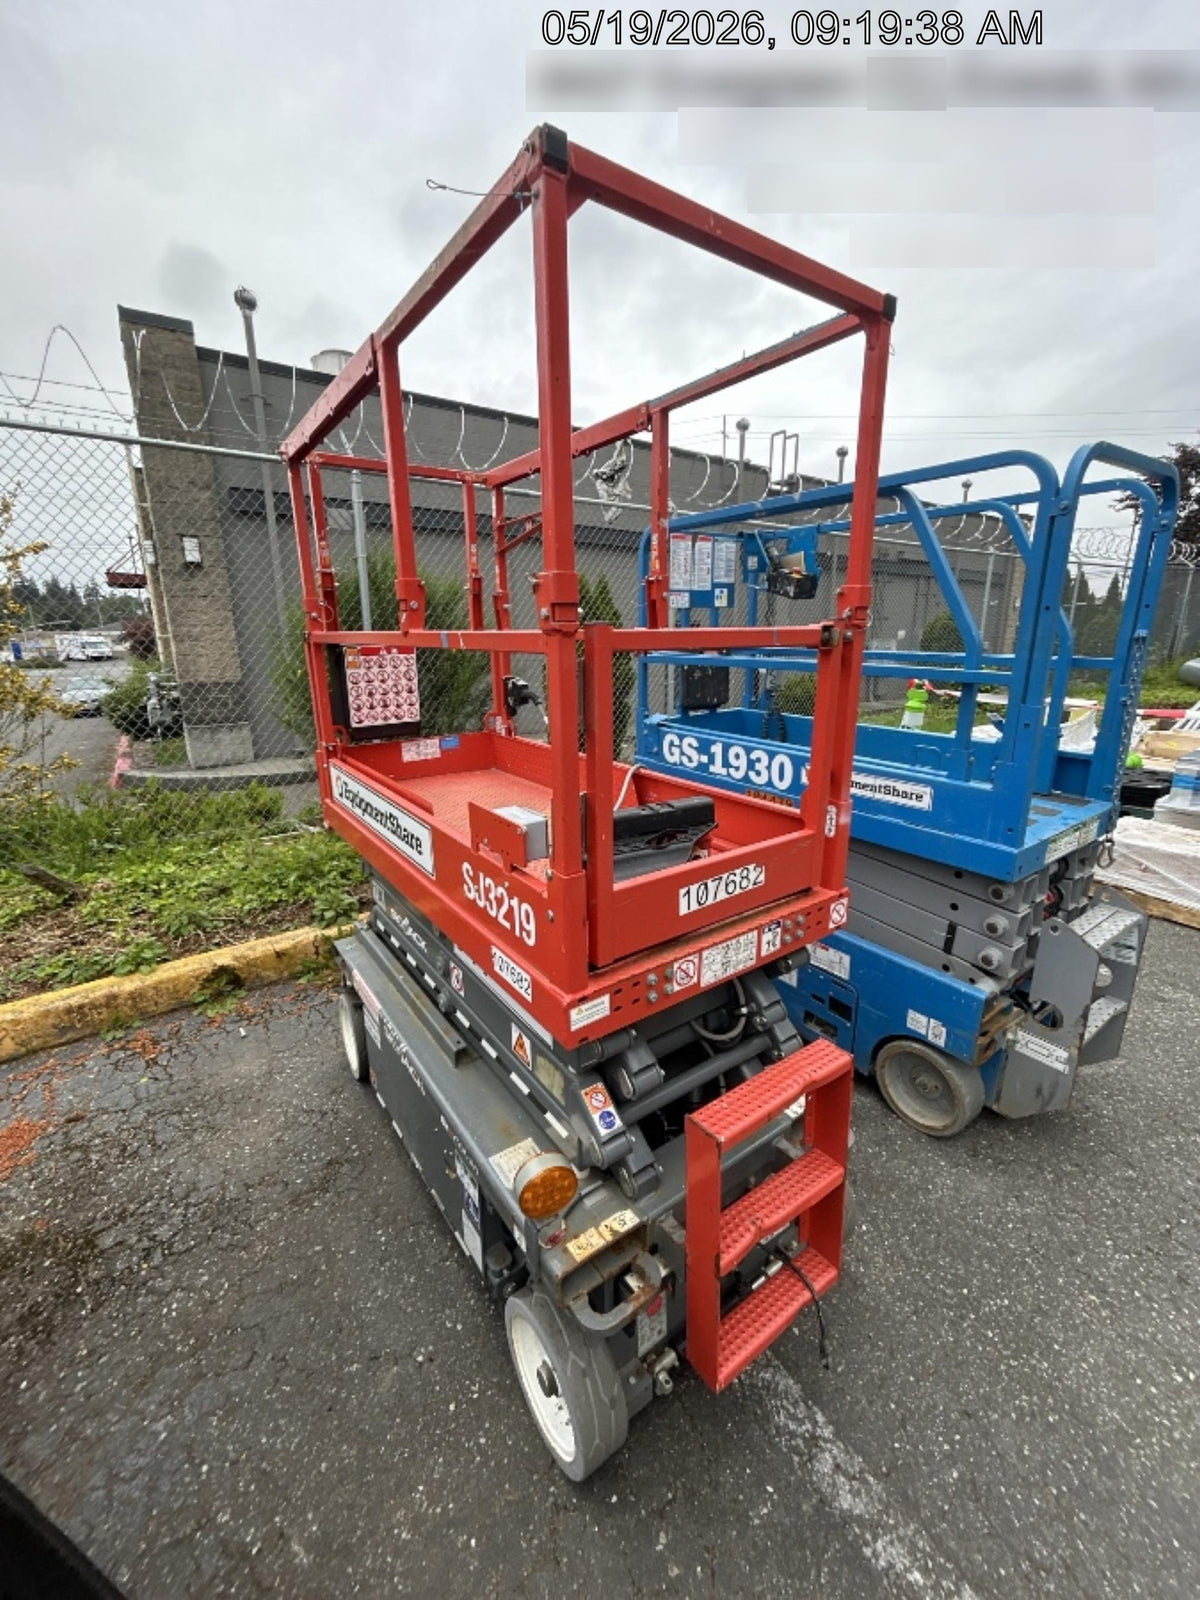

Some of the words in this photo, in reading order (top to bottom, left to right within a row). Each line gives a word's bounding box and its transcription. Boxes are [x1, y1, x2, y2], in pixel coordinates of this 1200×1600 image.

[662, 732, 794, 790] GS-1930
[338, 779, 424, 857] EquipmentShare
[850, 779, 924, 802] mentShare
[461, 861, 537, 948] SJ3219
[682, 865, 763, 911] 107682
